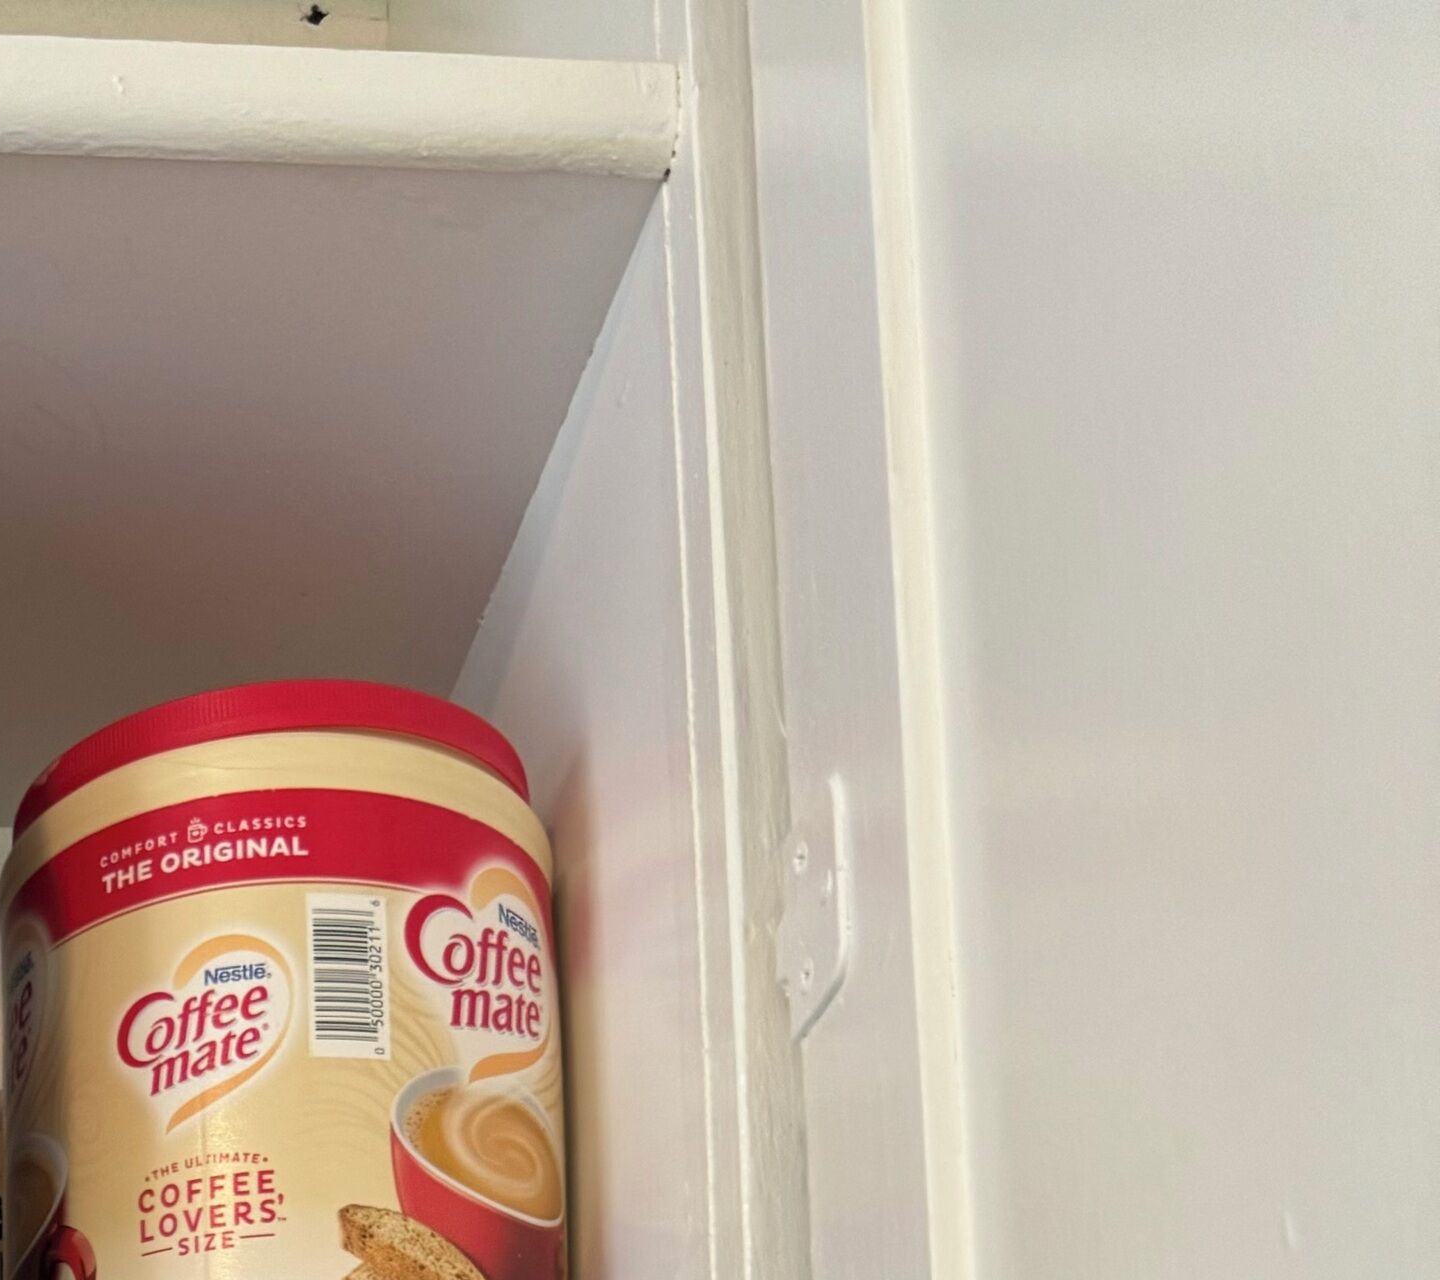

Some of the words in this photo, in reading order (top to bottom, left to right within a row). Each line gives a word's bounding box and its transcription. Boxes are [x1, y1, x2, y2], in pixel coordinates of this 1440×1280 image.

[99, 831, 178, 868] COMFORT
[213, 816, 308, 835] CLASSICS
[101, 859, 154, 894] THE
[159, 836, 309, 875] ORIGINAL
[404, 893, 543, 993] Coffee
[117, 984, 269, 1069] Coffee
[450, 988, 541, 1041] mate
[150, 1026, 262, 1097] mate
[138, 1168, 276, 1215] COFFEE
[150, 1160, 180, 1182] THE
[183, 1152, 261, 1171] ULTIMATE
[140, 1193, 286, 1244] LOVERS'
[178, 1230, 236, 1257] SIZE
